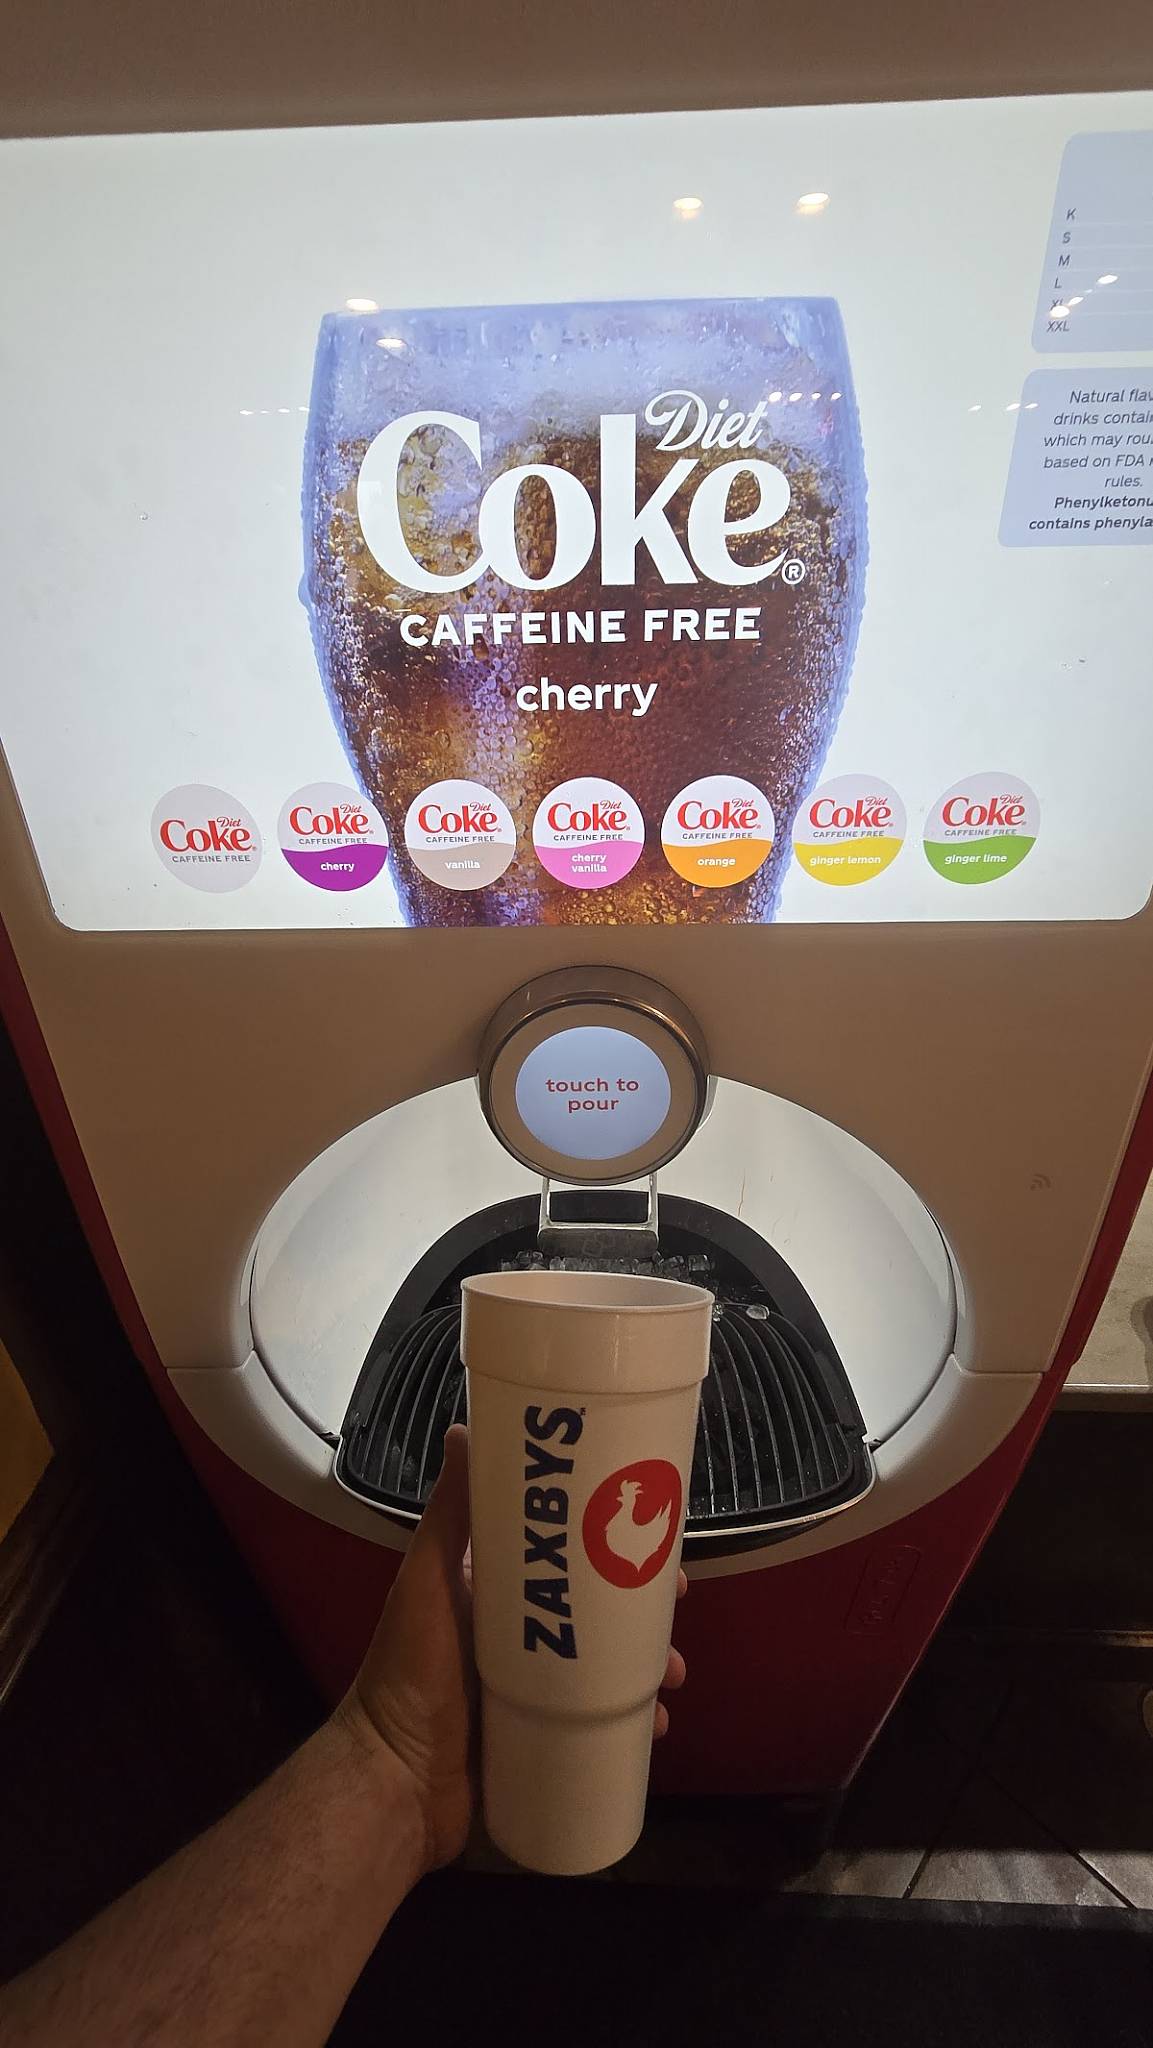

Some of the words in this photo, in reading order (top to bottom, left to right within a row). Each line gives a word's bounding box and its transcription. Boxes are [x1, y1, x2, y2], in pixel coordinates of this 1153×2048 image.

[1066, 207, 1077, 221] K
[1062, 231, 1072, 244] S
[1058, 254, 1071, 267] M
[1054, 277, 1062, 289] L
[1046, 320, 1070, 333] XXL
[1069, 389, 1125, 404] Natural
[644, 389, 769, 452] Diet
[1053, 411, 1099, 426] drinks
[1043, 433, 1087, 448] which
[1091, 434, 1123, 449] may
[1043, 455, 1089, 469] based
[1092, 456, 1111, 468] on
[1115, 454, 1145, 468] FDA
[1104, 474, 1143, 488] rules.
[1028, 517, 1091, 531] contains
[399, 609, 627, 648] CAFFEINE
[643, 606, 762, 641] FREE
[515, 677, 659, 718] cherry
[731, 797, 754, 808] Diet
[864, 795, 888, 806] Diet
[999, 793, 1024, 804] Diet
[340, 803, 361, 814] Diet
[469, 801, 491, 812] Diet
[600, 800, 622, 810] Diet
[217, 817, 242, 828] Diet
[600, 833, 624, 841] FREE
[682, 832, 727, 840] CAFFEINE
[944, 829, 990, 837] CAFFEINE
[992, 828, 1018, 836] FREE
[172, 855, 222, 863] CAFFEINE
[571, 853, 608, 863] cherry
[697, 857, 736, 868] orange
[809, 855, 845, 867] ginger
[847, 855, 881, 865] lemon
[944, 853, 981, 865] ginger
[983, 853, 1008, 863] lime
[320, 862, 355, 873] cherry
[445, 860, 481, 869] vanilla
[571, 863, 608, 873] vanilla
[545, 1077, 609, 1093] touch
[616, 1078, 639, 1092] to
[568, 1098, 619, 1114] pour
